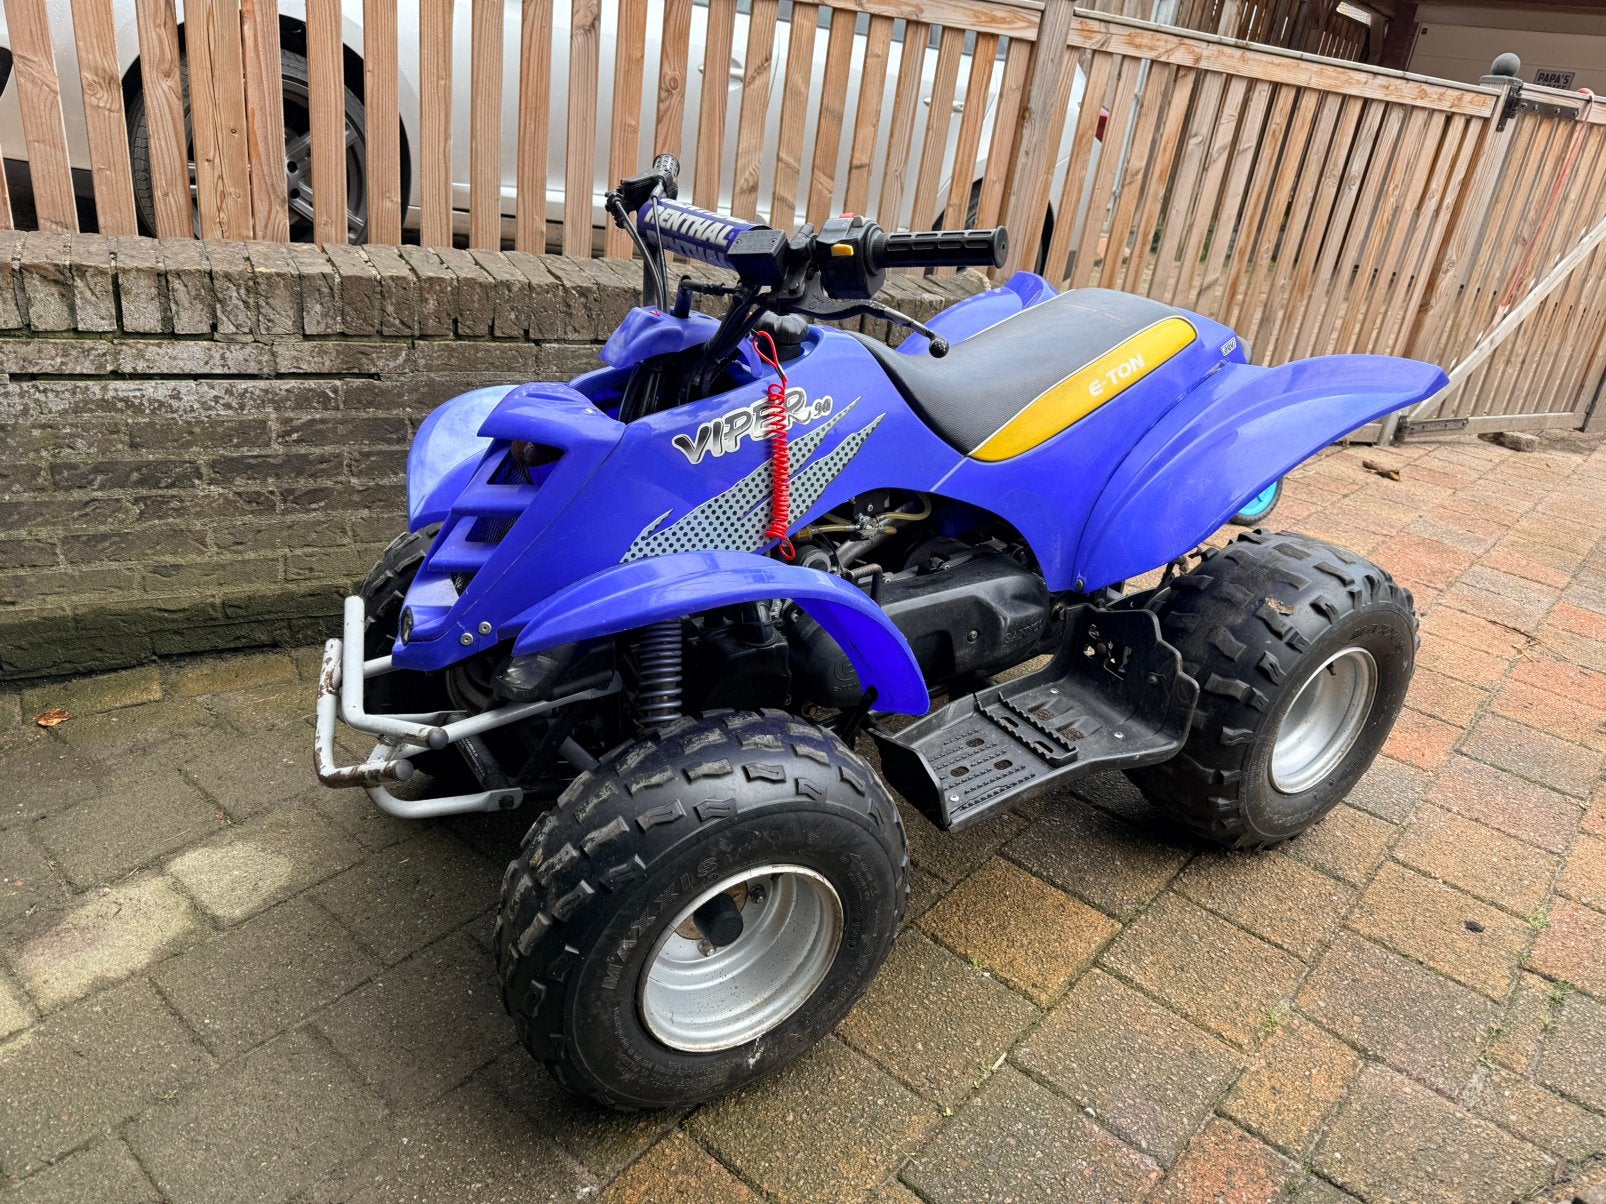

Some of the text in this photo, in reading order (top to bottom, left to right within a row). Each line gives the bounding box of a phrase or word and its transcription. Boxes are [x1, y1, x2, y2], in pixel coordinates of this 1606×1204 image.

[1537, 72, 1571, 85] PAPA'S
[643, 204, 735, 248] RENTHAL
[672, 387, 811, 464] VIPER
[601, 857, 717, 990] MAXXIS
